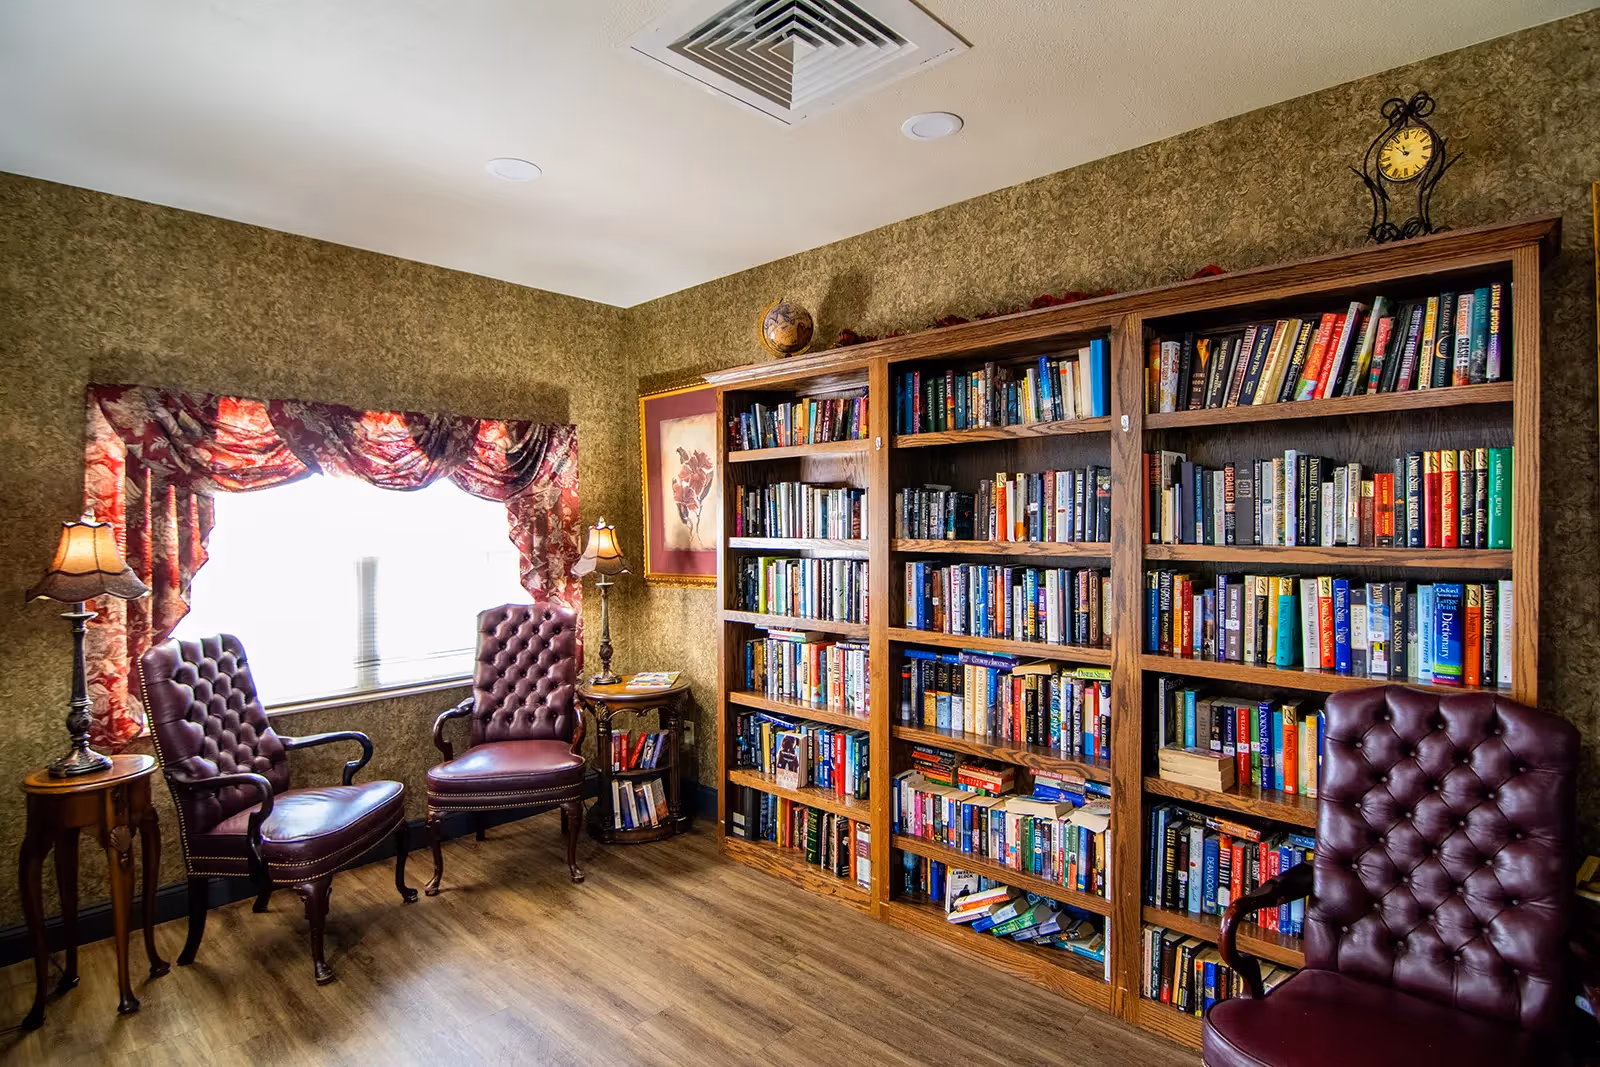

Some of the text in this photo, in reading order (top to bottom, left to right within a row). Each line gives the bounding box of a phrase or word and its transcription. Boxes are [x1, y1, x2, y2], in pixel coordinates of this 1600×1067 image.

[1251, 327, 1269, 375] The Timothy Files
[1402, 341, 1416, 367] FORGOTTEN
[1457, 338, 1470, 358] CRASH
[1225, 467, 1234, 502] DERAILED
[1309, 458, 1320, 502] DANIELLE STEEL
[1321, 598, 1331, 615] DANIELLE
[1373, 586, 1383, 606] DAVID
[1484, 589, 1496, 618] DANIELLE
[1322, 615, 1333, 629] STEEL
[1394, 620, 1402, 652] RANSOM
[1439, 613, 1453, 659] Dictionary
[1484, 619, 1495, 637] STEEL
[1051, 674, 1059, 734] LOUISE PENNY
[1259, 706, 1268, 755] LOOKING BACK
[1167, 829, 1175, 846] STEVE
[1206, 856, 1214, 900] DEAN KOONTZ
